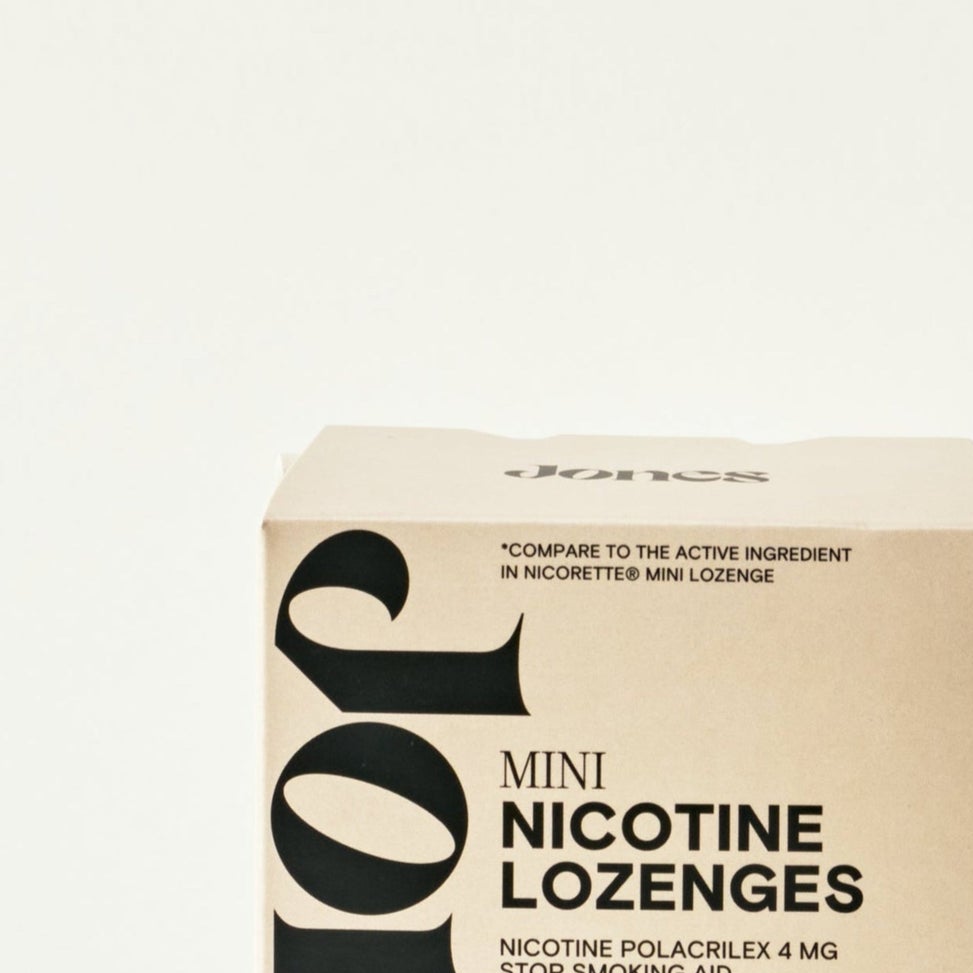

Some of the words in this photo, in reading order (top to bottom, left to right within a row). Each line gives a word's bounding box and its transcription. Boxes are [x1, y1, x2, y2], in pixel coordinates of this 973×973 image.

[503, 464, 771, 483] Jones
[606, 544, 631, 559] TO
[636, 544, 670, 559] THE
[675, 545, 739, 561] ACTIVE
[745, 546, 852, 562] INGREDIENT
[501, 565, 518, 579] IN
[646, 567, 683, 581] MINI
[690, 567, 774, 583] LOZENGE
[501, 751, 605, 790] MINI
[503, 801, 823, 852] NICOTINE
[502, 861, 863, 913] LOZENGES
[501, 939, 612, 958] NICOTINE
[622, 940, 770, 959] POLACRILEX
[778, 942, 791, 959] 4
[800, 942, 837, 960] MG
